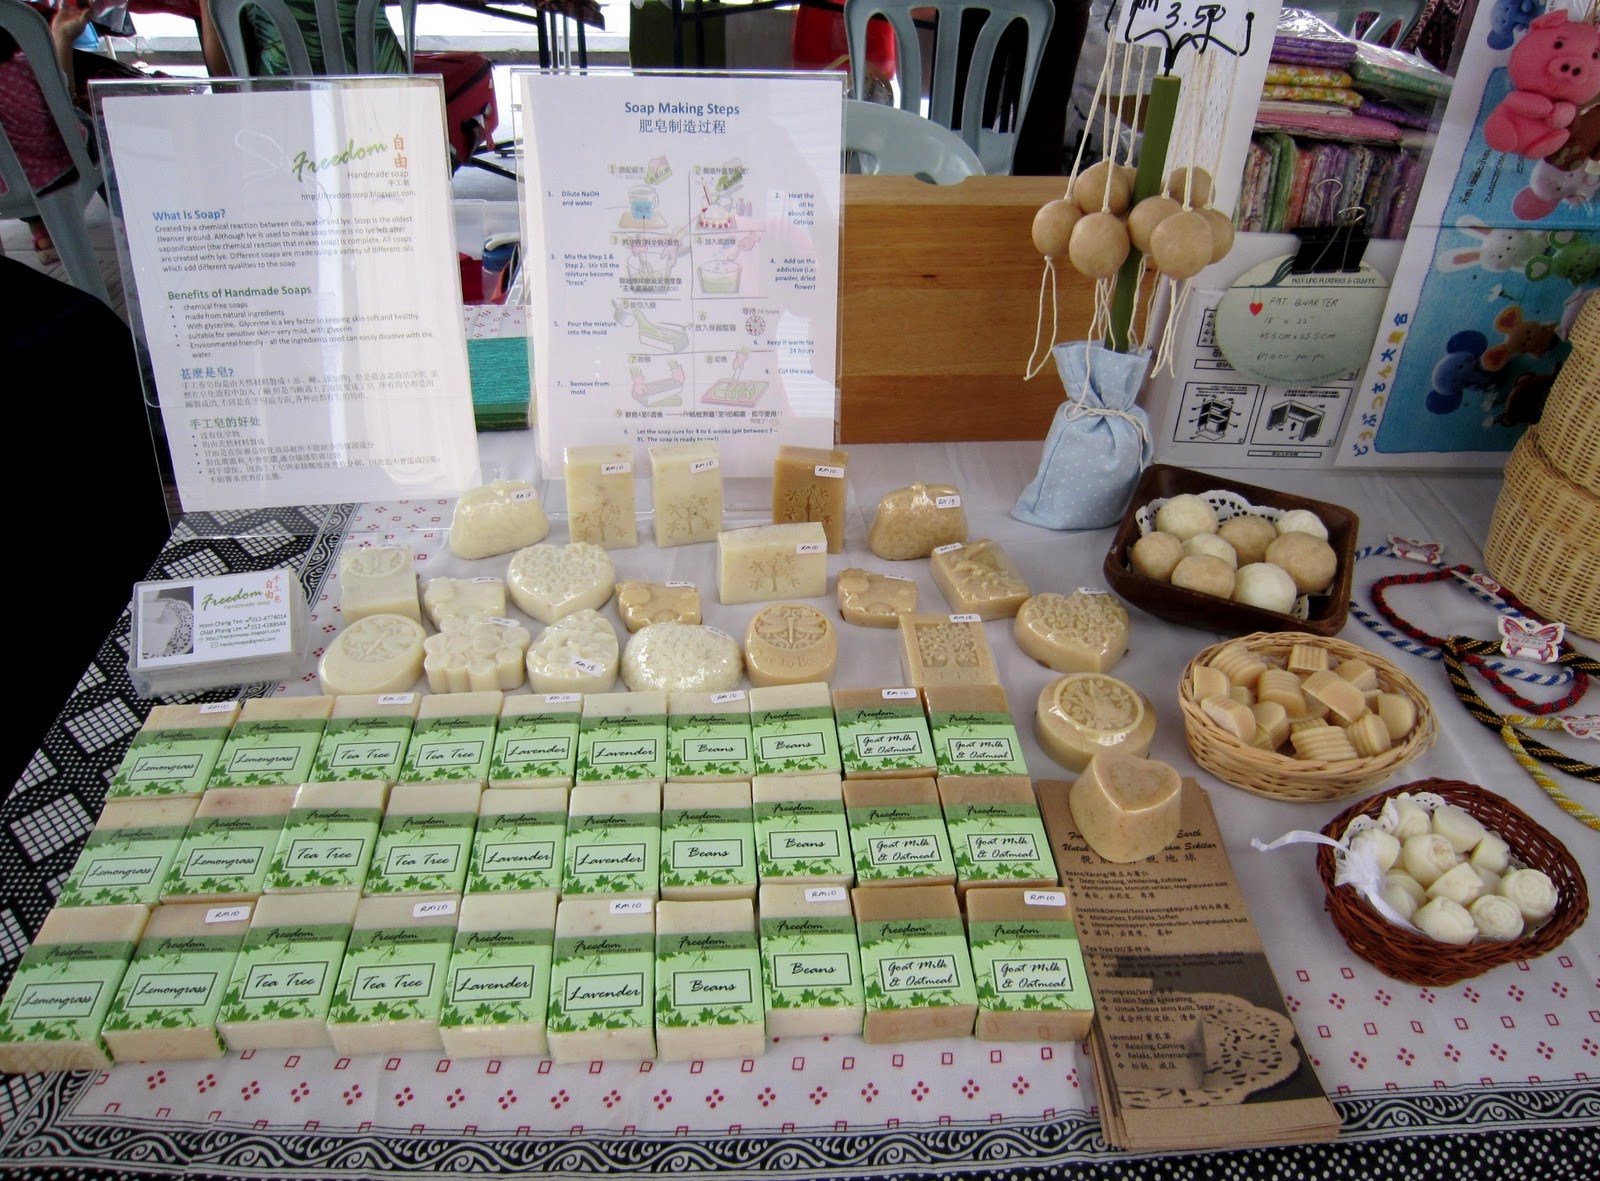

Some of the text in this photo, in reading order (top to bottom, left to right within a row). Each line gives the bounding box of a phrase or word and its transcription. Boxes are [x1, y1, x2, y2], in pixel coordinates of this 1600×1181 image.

[625, 102, 739, 117] Soap Making Steps
[639, 119, 726, 135] 肥皂制造过程
[394, 134, 408, 169] 自由
[292, 138, 387, 182] Freedom
[347, 171, 389, 179] Handmade
[153, 209, 225, 221] What Is Soap?
[199, 222, 229, 231] chemical
[230, 222, 258, 230] reaction
[157, 235, 184, 243] cleanser
[215, 232, 245, 241] Although
[198, 260, 265, 270] different qualities to
[168, 285, 312, 300] Benefits of Handmade Soaps
[213, 302, 227, 310] free
[248, 310, 284, 318] ingredients
[695, 461, 714, 470] RM10
[201, 588, 263, 611] Freedom
[774, 740, 812, 750] Beans
[864, 734, 912, 745] Goat Milk
[955, 741, 976, 750] Goat
[508, 744, 566, 757] Lavender
[595, 746, 653, 759] Lavender
[697, 743, 735, 753] Beans
[878, 745, 917, 754] Oatmeal
[341, 749, 391, 761] Tea Tree
[426, 749, 475, 761] Tea Tree
[970, 751, 1008, 759] Oatmeal
[235, 753, 293, 771] Lemongrass
[136, 761, 195, 777] Lemongrass
[772, 803, 814, 813] Freedom
[967, 806, 1008, 816] Freedom
[306, 810, 351, 821] Freedom
[494, 814, 537, 825] Freedom
[678, 811, 721, 822] Freedom
[869, 809, 911, 820] Freedom
[402, 816, 445, 828] Freedom
[584, 815, 627, 827] Freedom
[784, 838, 826, 848] Beans
[876, 838, 930, 851] Goat Milk
[976, 836, 1029, 847] Goat Milk
[296, 847, 353, 860] Tea Tree
[486, 851, 550, 864] Lavender
[687, 847, 729, 858] Beans
[878, 851, 935, 861] & Oatmeal
[977, 849, 1034, 858] & Oatmeal
[191, 855, 255, 869] Lemongrass
[395, 853, 450, 866] Tea Tree
[577, 852, 643, 866] Lavender
[88, 865, 152, 880] Lemongrass
[812, 890, 837, 898] RM10
[420, 904, 448, 912] RM10
[615, 902, 642, 910] RM10
[214, 910, 240, 918] RM10
[777, 920, 824, 932] Freedom
[880, 923, 927, 936] Freedom
[994, 925, 1040, 936] Freedom
[267, 928, 314, 941] Freedom
[371, 930, 419, 943] Freedom
[467, 932, 515, 945] Freedom
[158, 939, 207, 951] Freedom
[573, 939, 622, 953] Freedom
[678, 936, 726, 948] Freedom
[46, 945, 94, 959] Freedom
[790, 963, 836, 975] Beans
[888, 959, 948, 976] Goat Milk
[1001, 963, 1062, 977] Goat Milk
[255, 972, 315, 988] Tea Tree
[362, 974, 424, 990] Tea Tree
[457, 976, 530, 992] Lavender
[890, 974, 953, 987] & Oatmeal
[1002, 978, 1066, 989] & Oatmeal
[137, 982, 208, 999] Lemongrass
[690, 980, 737, 993] Beans
[568, 985, 640, 1001] Lavender
[21, 991, 93, 1010] Lemongrass
